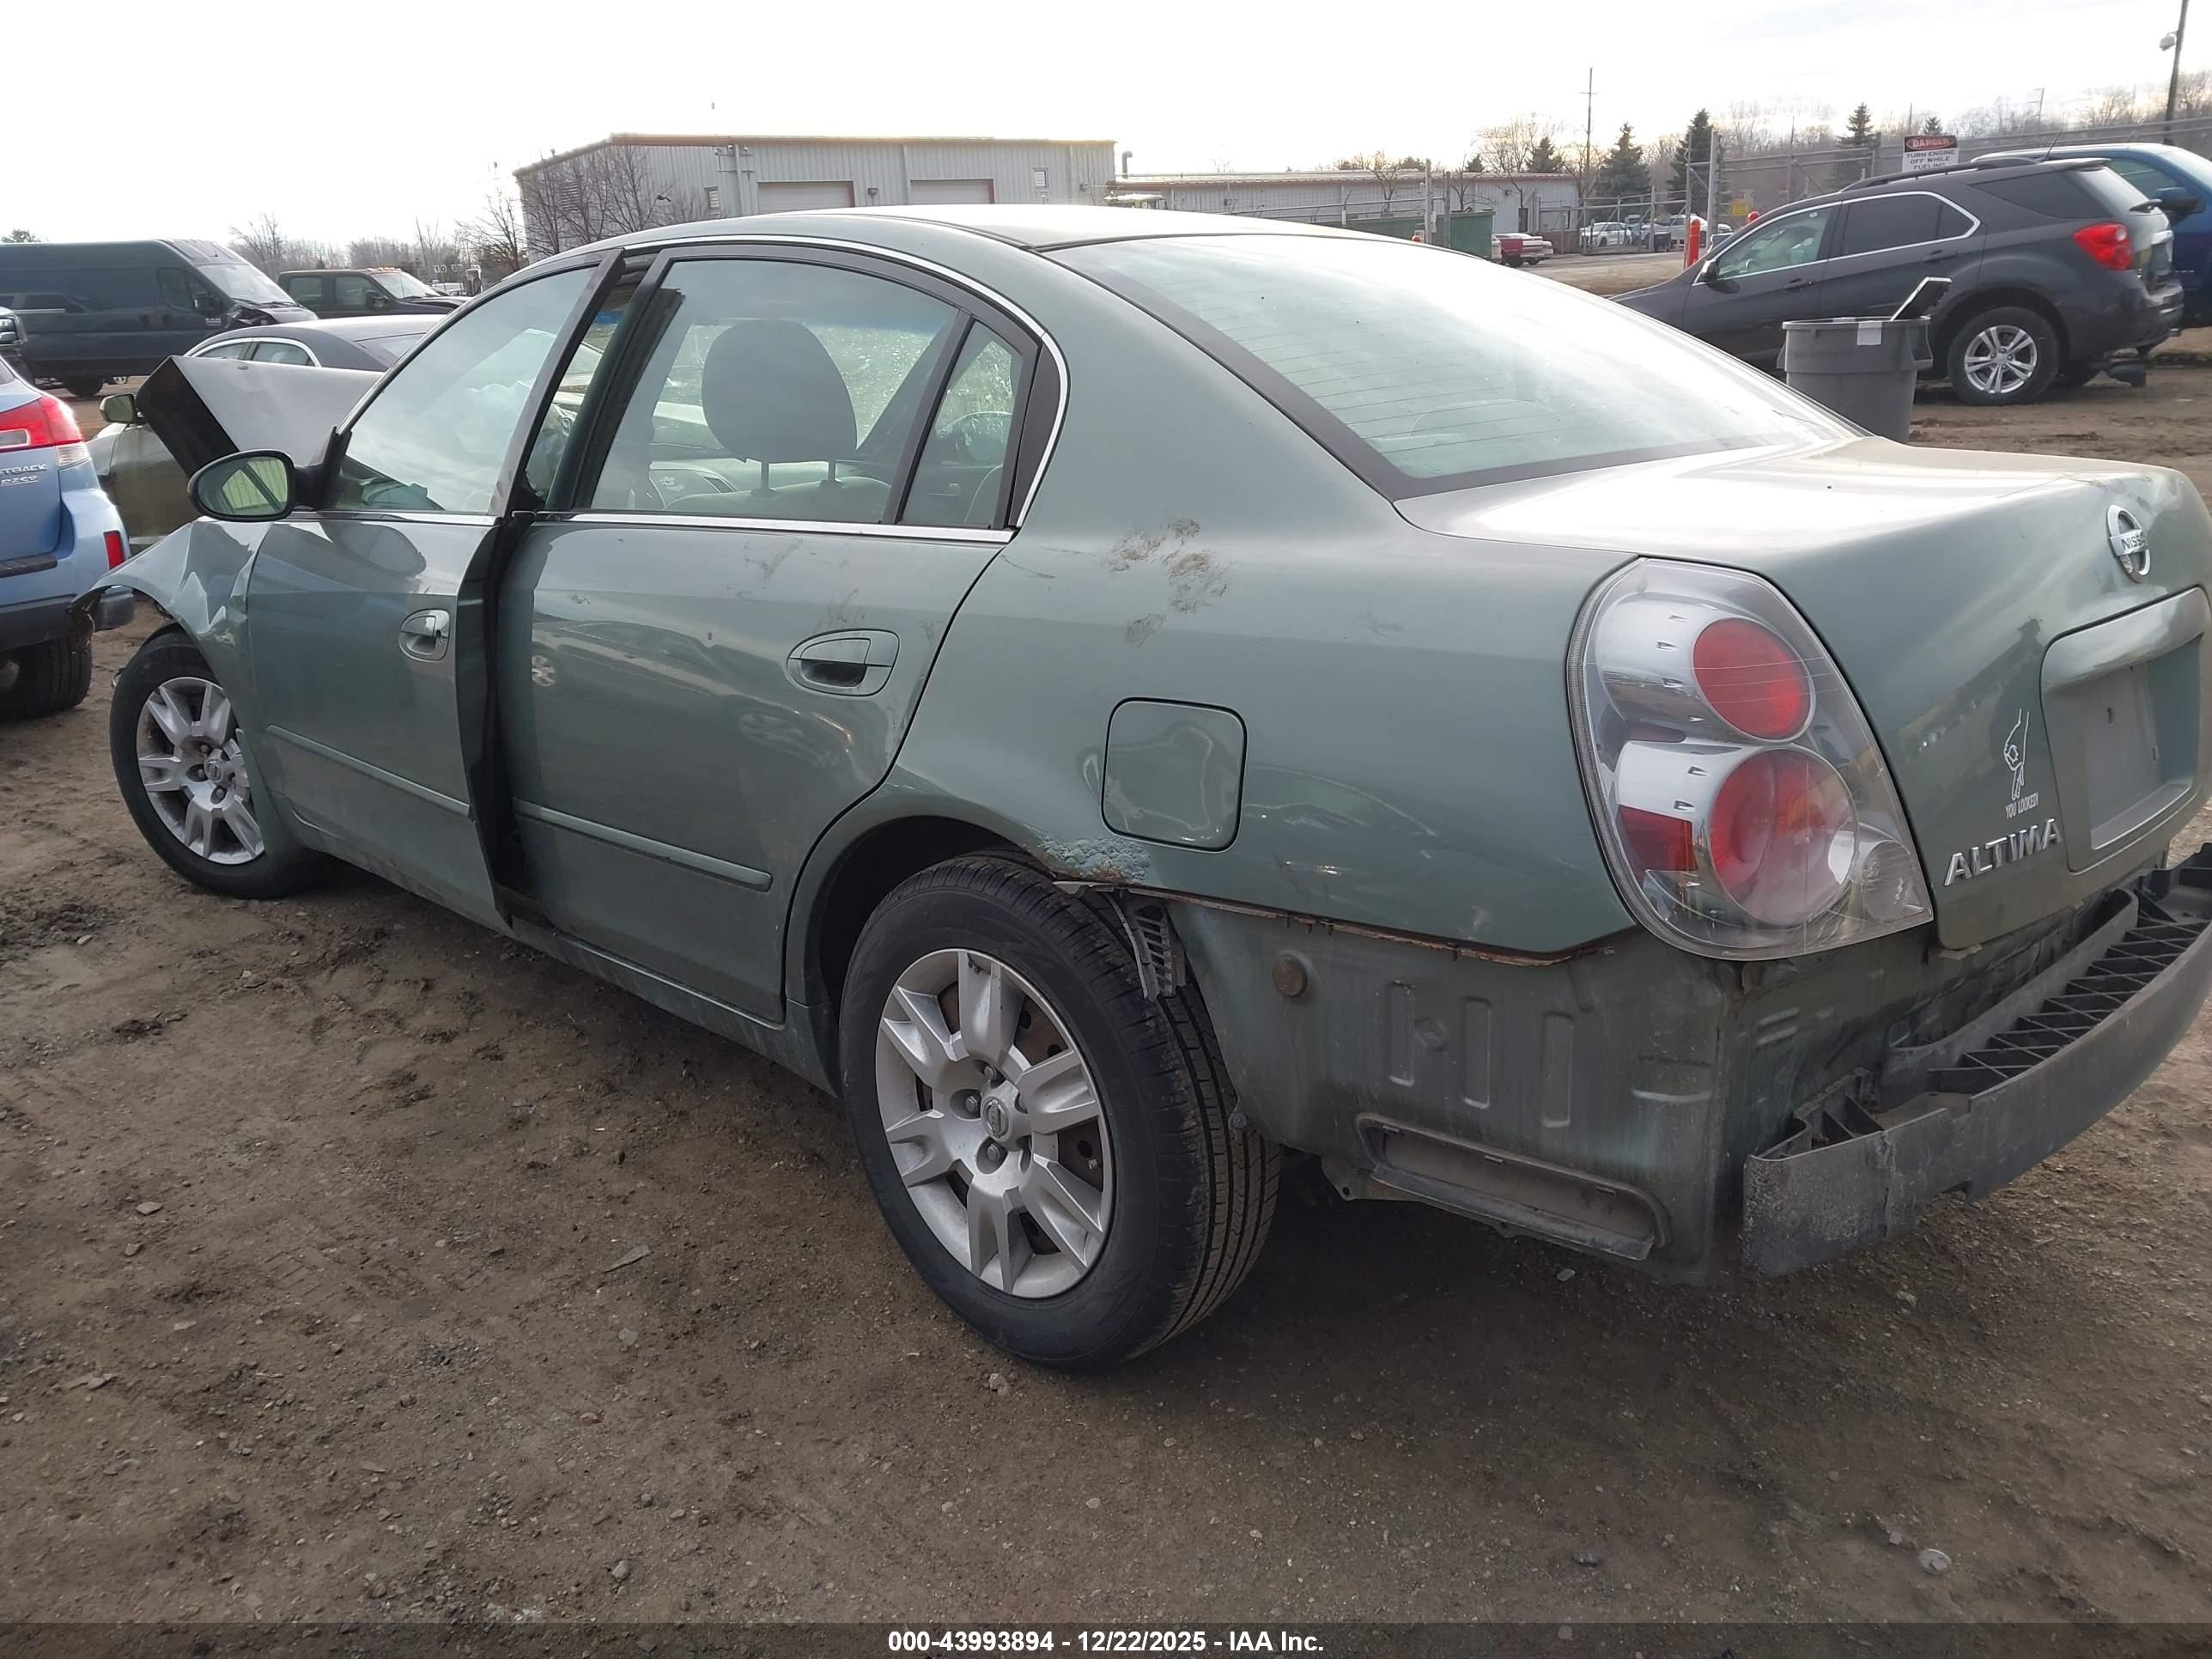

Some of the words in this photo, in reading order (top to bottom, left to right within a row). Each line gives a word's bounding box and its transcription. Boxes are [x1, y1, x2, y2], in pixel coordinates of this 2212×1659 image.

[0, 463, 47, 474] TBACK
[2121, 532, 2144, 550] NISS
[2005, 801, 2017, 819] YOU
[2018, 791, 2039, 814] LOOKED!
[1943, 818, 2062, 886] ALTIMA
